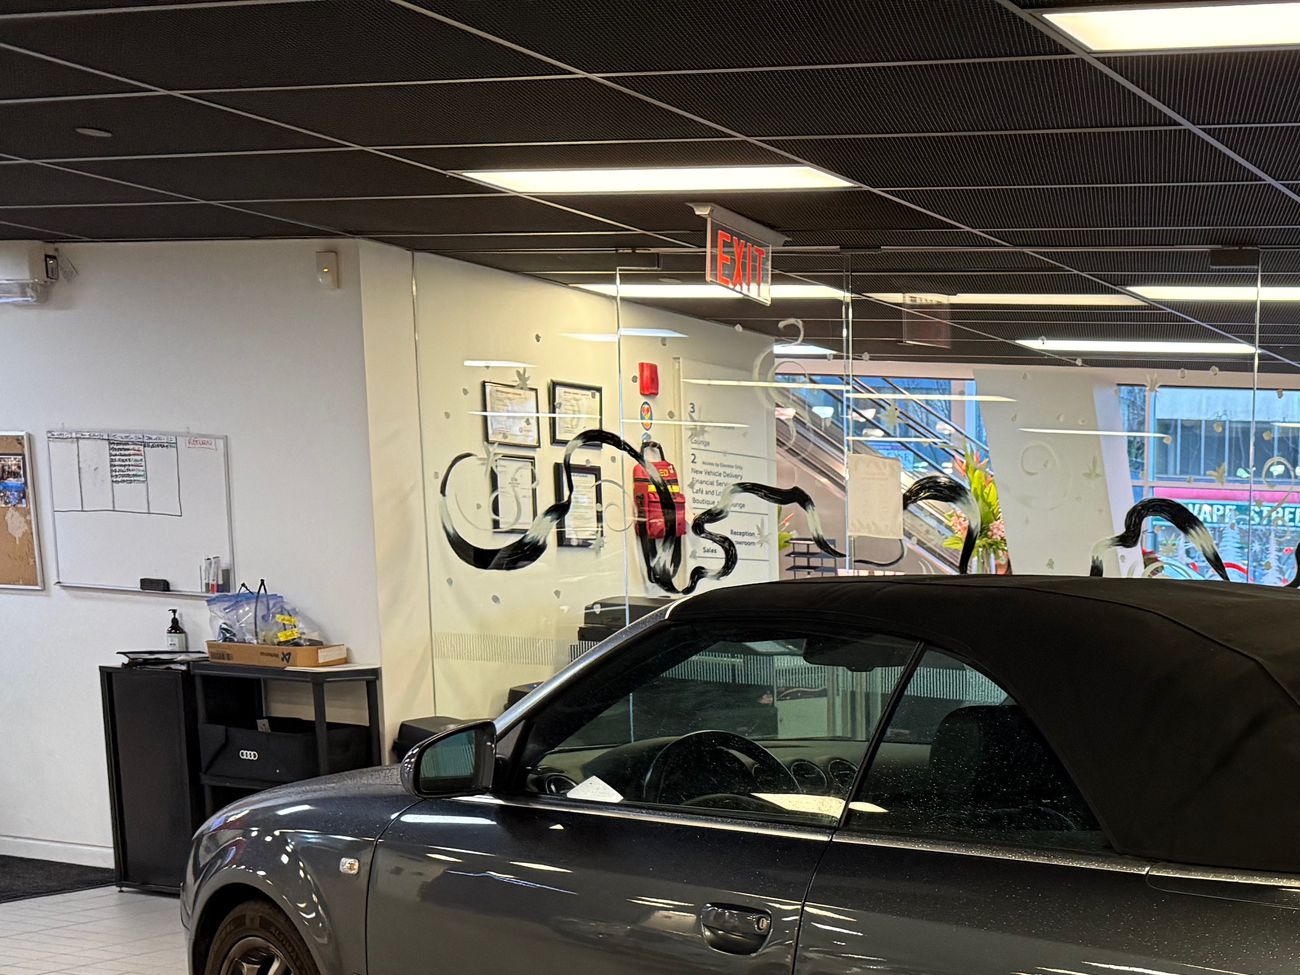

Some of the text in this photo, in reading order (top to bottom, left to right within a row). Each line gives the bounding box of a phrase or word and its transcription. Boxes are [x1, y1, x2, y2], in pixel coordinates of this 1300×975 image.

[717, 229, 767, 297] EXIT
[689, 403, 696, 413] 3
[691, 453, 697, 464] 2
[723, 471, 743, 480] Delivery
[692, 477, 714, 486] Financial
[692, 497, 715, 506] Boutique
[730, 529, 756, 537] Reception
